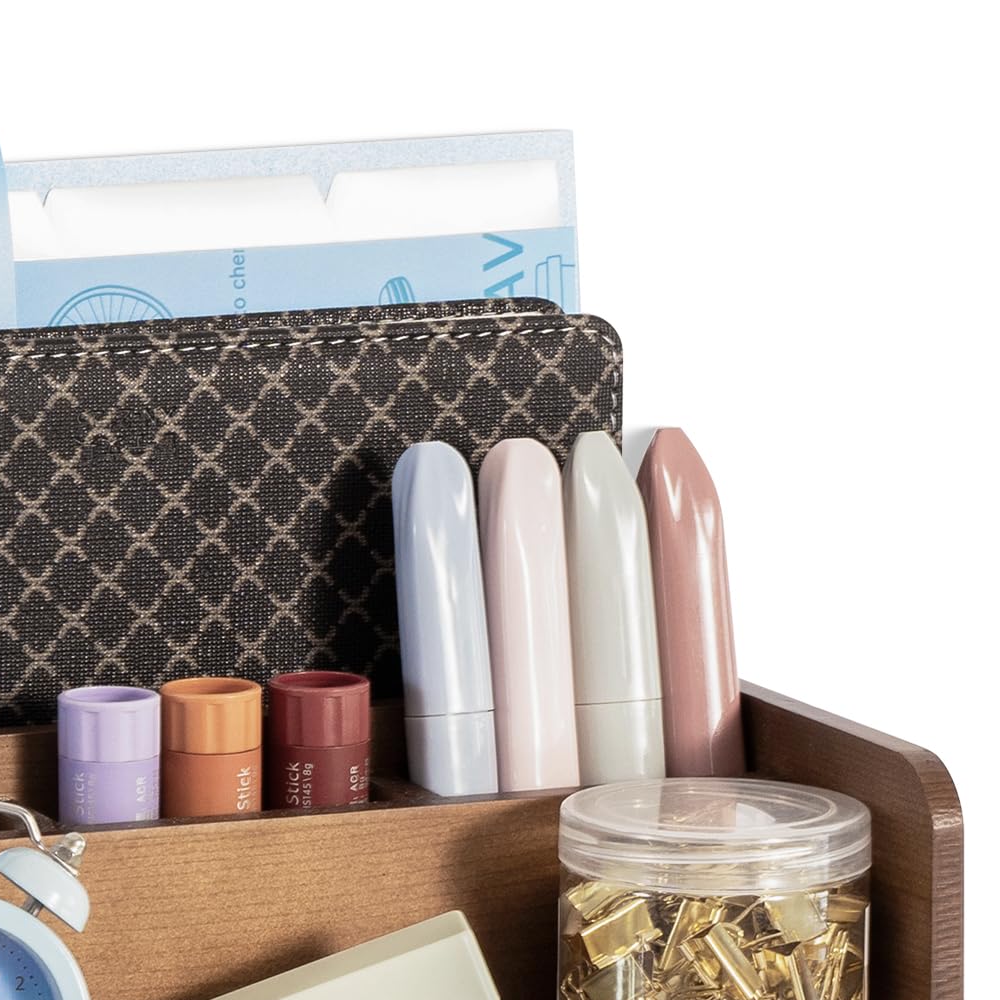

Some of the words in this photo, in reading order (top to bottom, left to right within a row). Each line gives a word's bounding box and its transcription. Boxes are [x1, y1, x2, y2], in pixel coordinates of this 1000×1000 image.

[236, 765, 252, 811] Stick
[284, 761, 301, 806] Stick
[14, 975, 26, 992] 2
